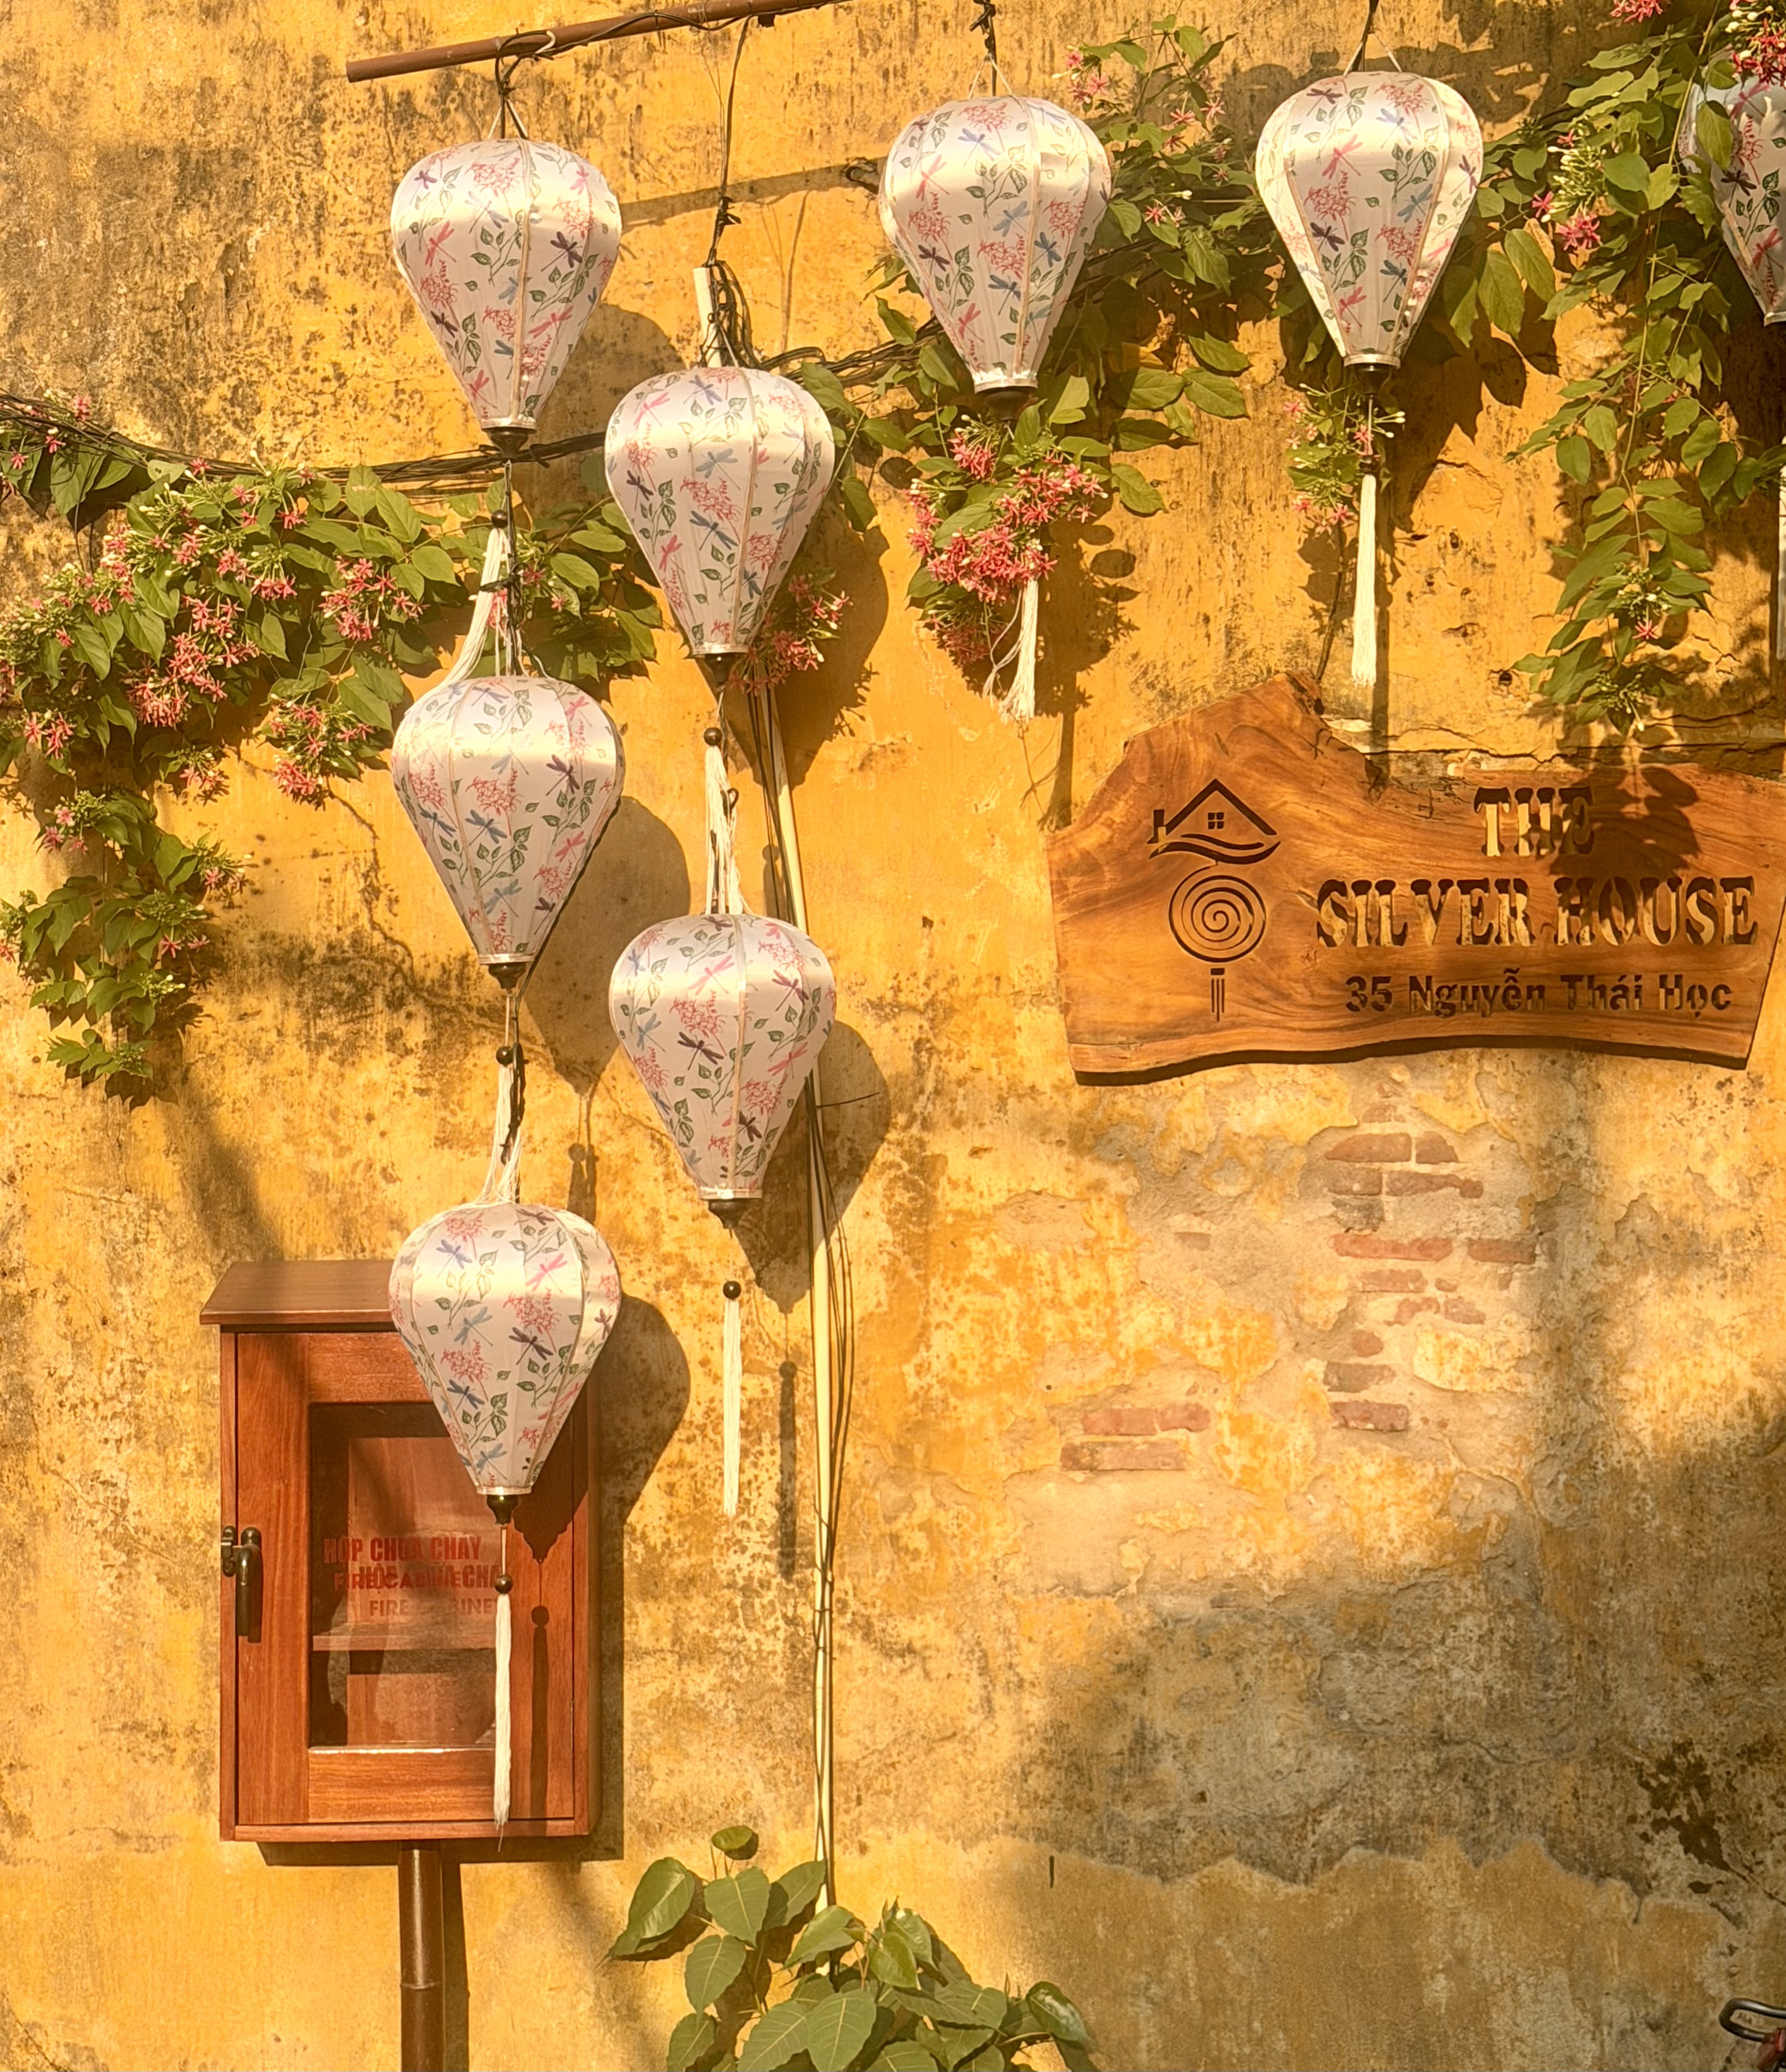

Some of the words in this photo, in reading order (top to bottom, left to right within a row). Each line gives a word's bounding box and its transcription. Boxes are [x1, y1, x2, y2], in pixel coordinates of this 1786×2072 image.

[1474, 787, 1594, 857] THE
[1316, 877, 1537, 947] SILVER
[1554, 875, 1758, 946] HOUSE
[1345, 976, 1393, 1012] 35
[1409, 967, 1546, 1018] Nguyễn
[1560, 974, 1642, 1011] Thái
[1658, 974, 1732, 1018] Học
